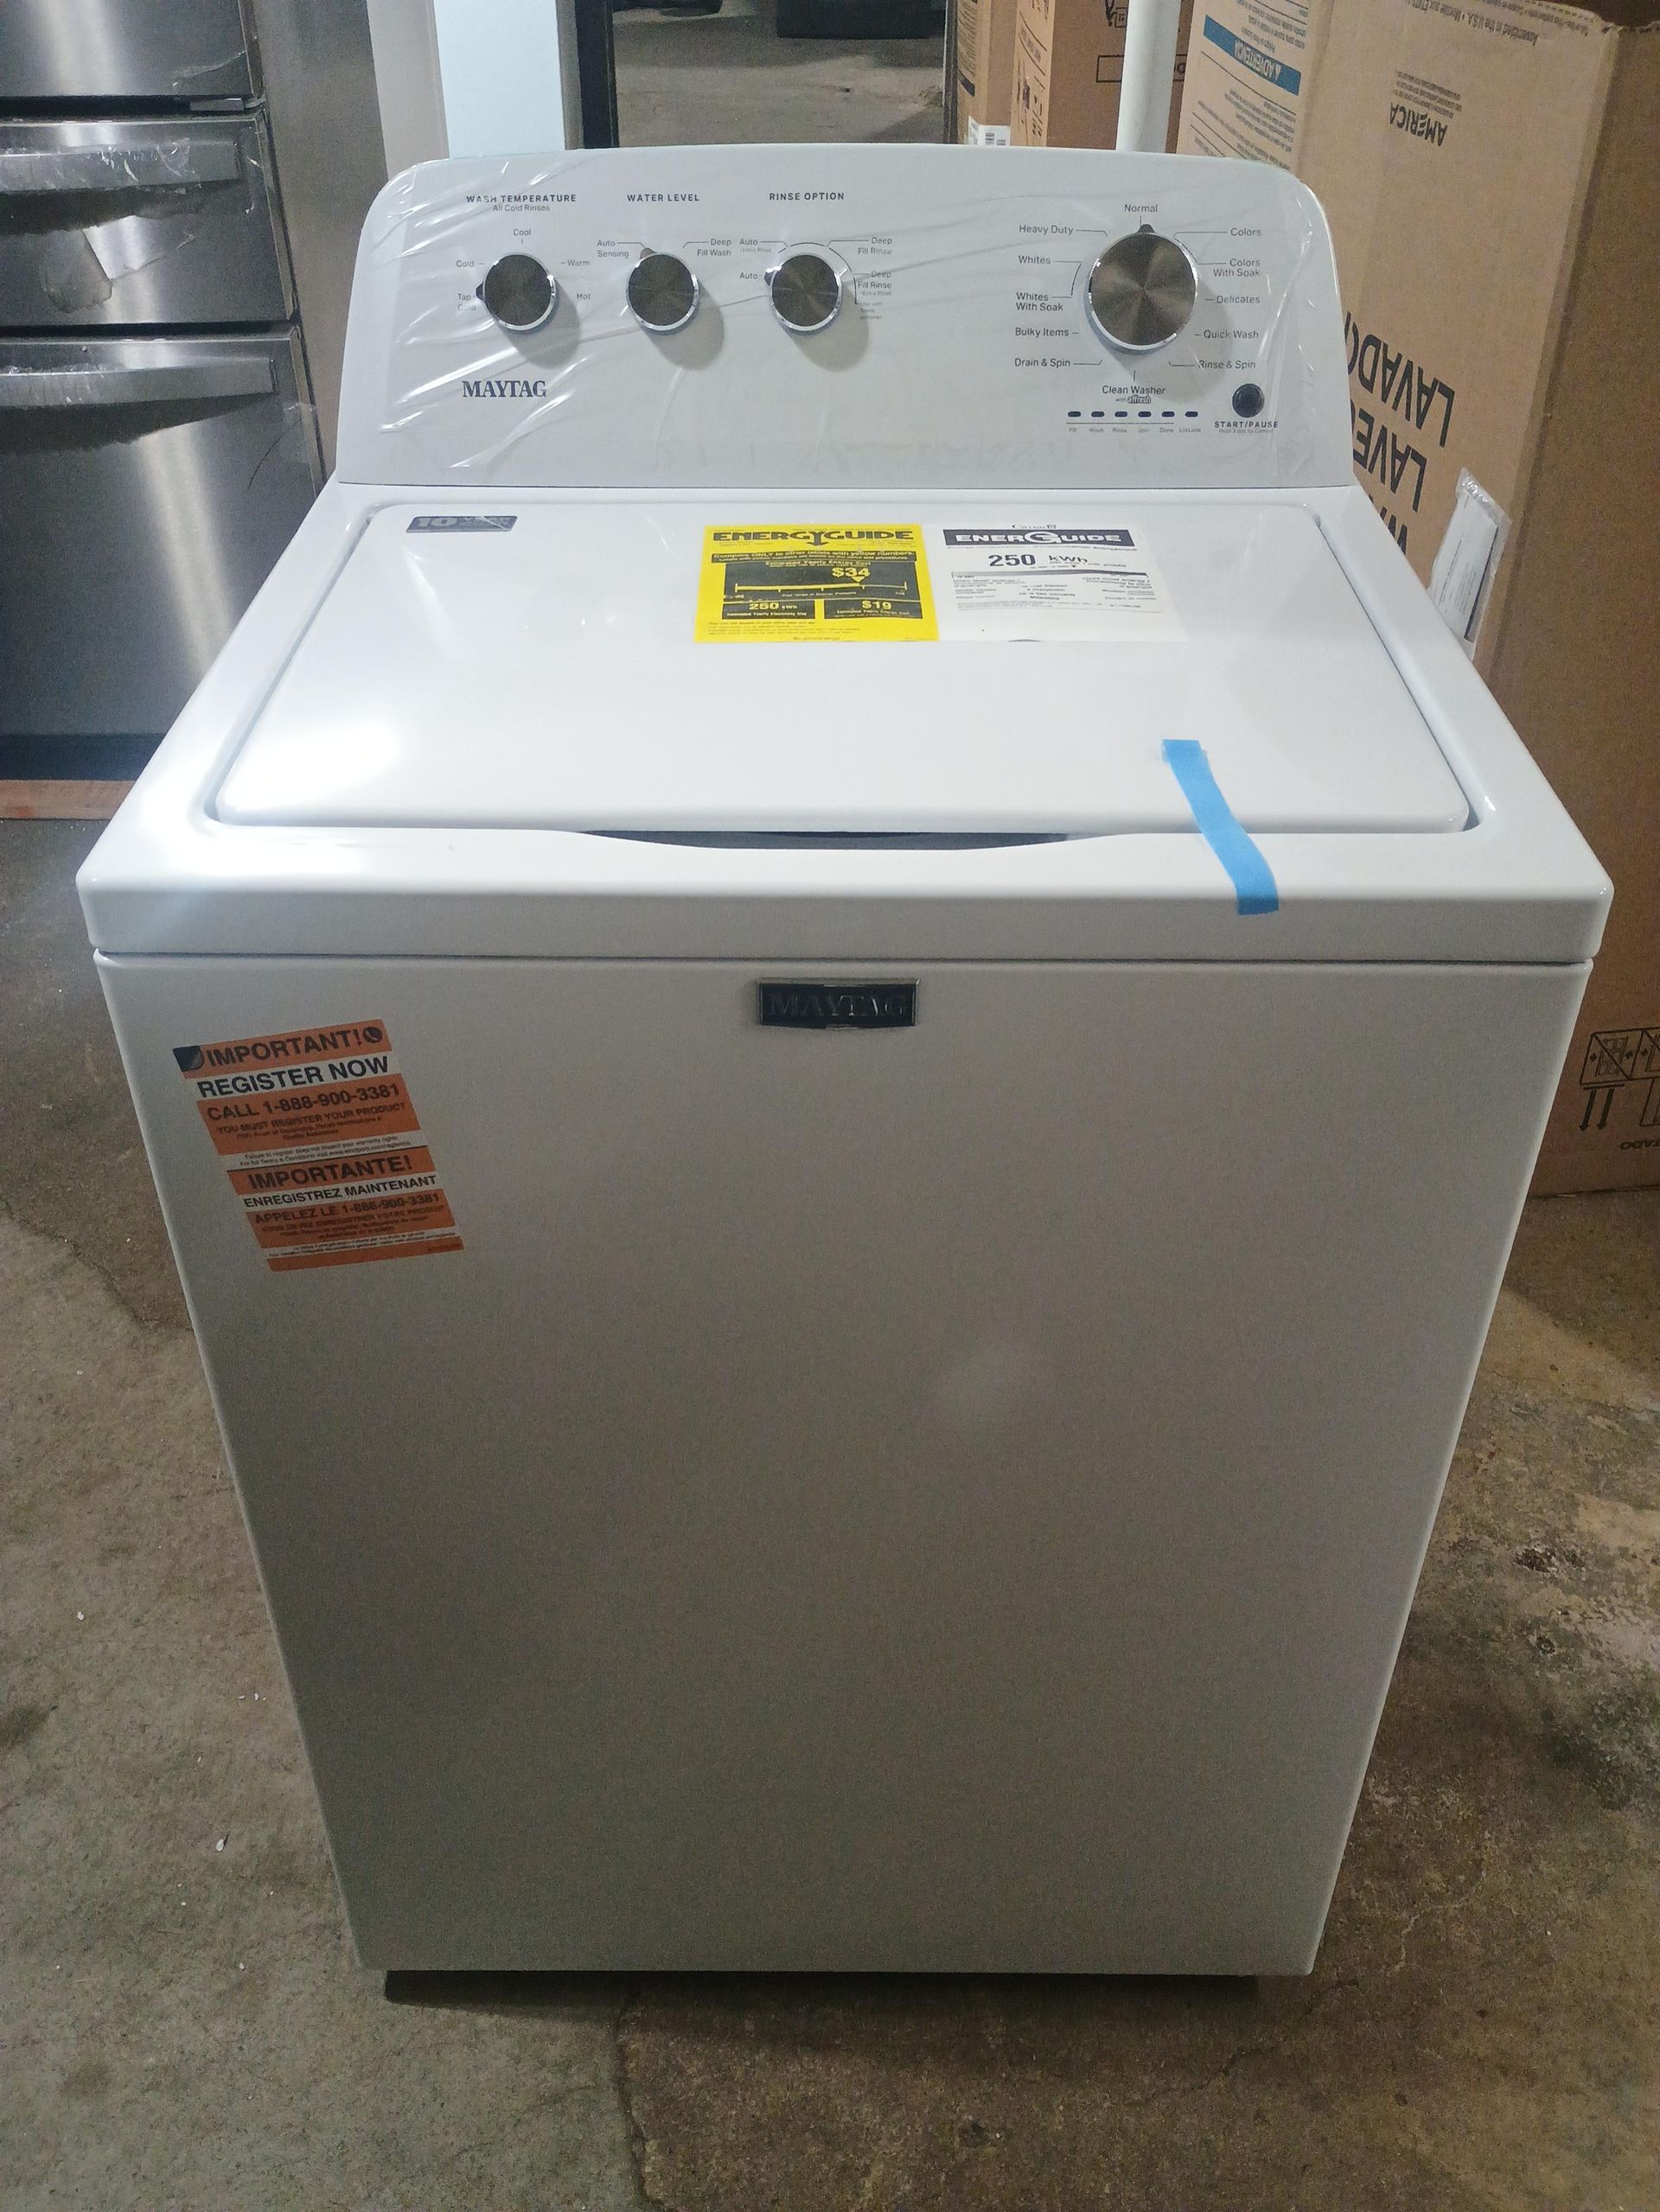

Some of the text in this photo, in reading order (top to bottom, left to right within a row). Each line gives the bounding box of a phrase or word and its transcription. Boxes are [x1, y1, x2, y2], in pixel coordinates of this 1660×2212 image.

[1389, 101, 1448, 147] AMERICA
[500, 194, 577, 203] TEMPERATURE
[626, 193, 700, 202] WATER LEVEL
[769, 192, 845, 201] RINSE OPTION
[1124, 204, 1158, 213] Normal
[1019, 225, 1073, 235] Heavy Duty
[1231, 228, 1261, 236] Colors
[710, 238, 732, 247] Deep
[871, 237, 893, 245] Deep
[597, 250, 630, 259] Sensing
[697, 249, 710, 257] Fill
[1018, 255, 1051, 264] Whites
[1229, 258, 1261, 267] Colors
[871, 271, 892, 279] Deep
[1213, 269, 1261, 277] With Soak
[457, 293, 472, 301] Tap
[1016, 293, 1049, 301] Whites
[1216, 295, 1261, 303] Delicates
[1016, 303, 1063, 311] With Soak
[1015, 328, 1069, 338] Bulky Items
[1204, 330, 1259, 339] Quick Wash
[1014, 358, 1070, 369] Drain & Spin
[1198, 360, 1256, 370] Rinse & Spin
[1344, 311, 1455, 448] LAVADO
[462, 380, 547, 398] MAYTAG
[1102, 386, 1166, 395] Clean Washer
[1350, 399, 1427, 513] LAVE
[713, 531, 914, 545] ENERGYGUIDE
[955, 531, 1122, 544] ENERGUIDE
[988, 554, 1036, 567] 250
[831, 567, 871, 578] $34
[749, 602, 779, 610] 250
[861, 600, 892, 610] $19
[767, 994, 908, 1017] MAYTAG
[206, 1030, 362, 1067] IMPORTANT!
[197, 1056, 388, 1098] REGISTER NOW
[208, 1083, 399, 1121] CALL 1-888-900-3381
[217, 1125, 239, 1134] YOU
[240, 1121, 268, 1131] MUST
[271, 1113, 322, 1128] REGISTER
[324, 1109, 354, 1120] YOUR
[355, 1102, 406, 1116] PRODUCT
[248, 1155, 412, 1189] IMPORTANTE!
[243, 1175, 437, 1208] ENREGISTREZ MAINTENANT
[255, 1193, 440, 1224] APPELEZ LE 1-888-900-3381
